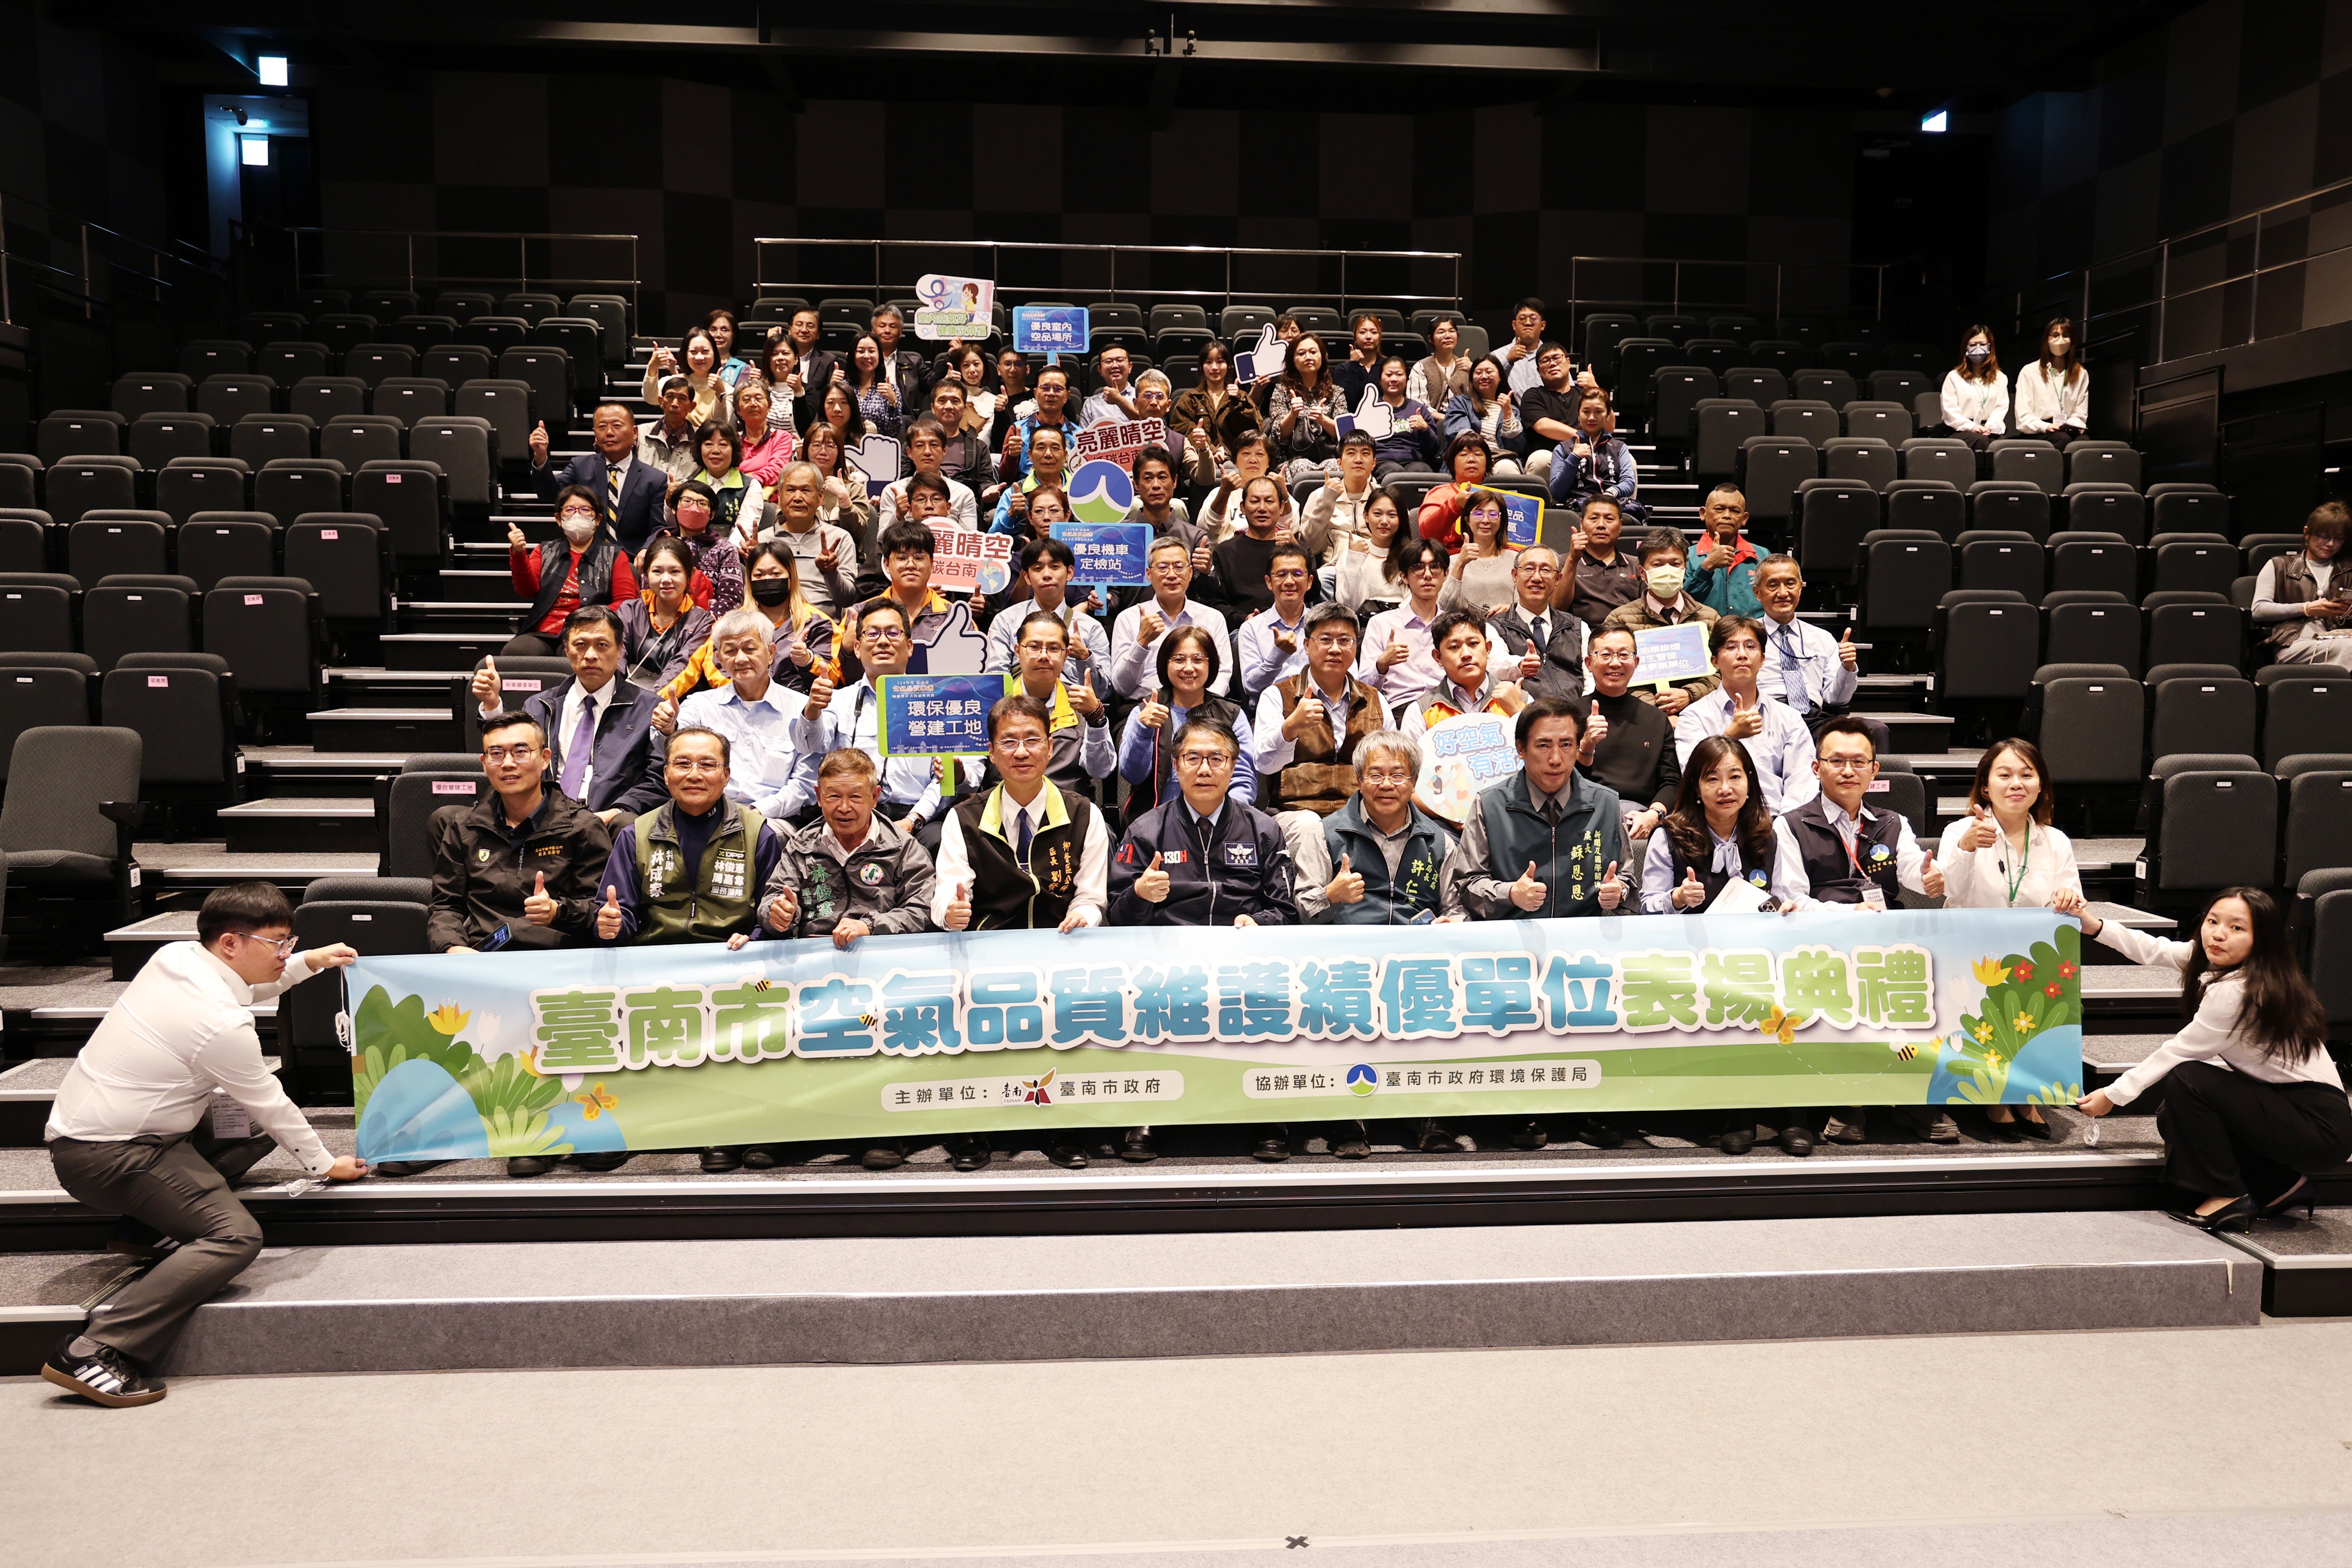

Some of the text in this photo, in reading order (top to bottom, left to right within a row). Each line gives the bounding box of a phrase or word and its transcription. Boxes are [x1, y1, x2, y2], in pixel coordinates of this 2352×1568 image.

[917, 312, 968, 325] 室內空氣好
[1031, 322, 1072, 331] 優良室內
[1031, 332, 1073, 342] 空品場所
[1075, 420, 1164, 455] 亮麗晴空
[1073, 543, 1129, 556] 優良機車
[1080, 558, 1122, 570] 定檢站
[1636, 643, 1681, 656] 油車排煙
[1635, 660, 1690, 673] 優事業單位
[908, 699, 982, 716] 環保優良
[908, 719, 983, 736] 營建工地
[1434, 722, 1504, 757] 好空氣
[665, 849, 674, 871] 特助
[1049, 846, 1059, 866] 區長
[1594, 830, 1602, 892] 新聞及國際關係
[649, 849, 665, 898] 林成家
[714, 860, 745, 874] 林俊憲
[1570, 845, 1585, 900] 蘇恩恩
[2139, 866, 2143, 875] B
[133, 873, 137, 883] B
[711, 886, 743, 897] 服務團隊
[811, 864, 836, 918] 林俊憲
[535, 949, 1933, 1069] 臺南市空氣品質維護績優單位表揚典禮
[1255, 1067, 1587, 1091] 協辦單位： 臺南市政府環境保護局
[894, 1085, 988, 1104] 主辦單位：
[1059, 1078, 1161, 1097] 臺南市政府
